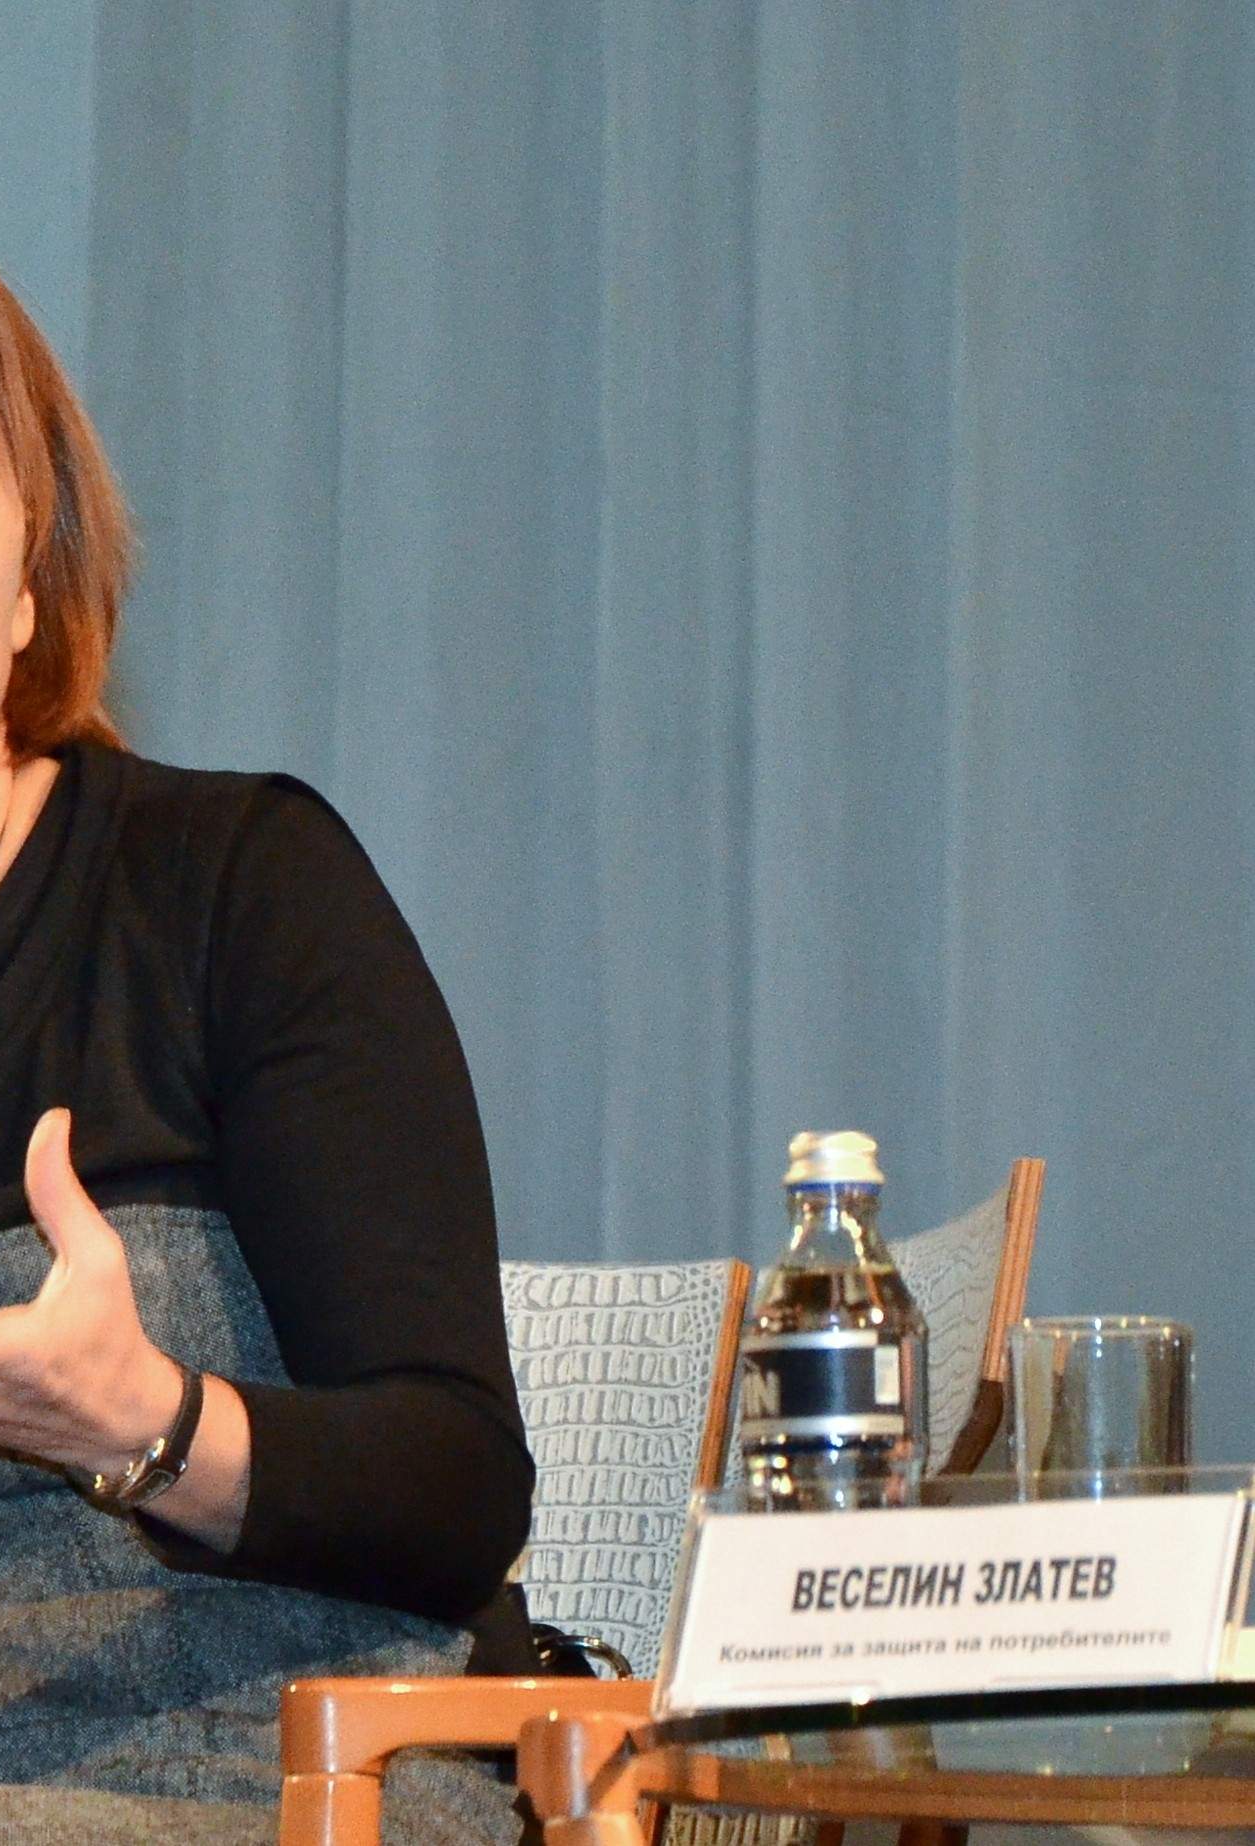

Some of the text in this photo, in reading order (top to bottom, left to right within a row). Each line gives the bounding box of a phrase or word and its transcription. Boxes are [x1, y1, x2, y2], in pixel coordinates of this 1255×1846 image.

[792, 1555, 1116, 1612] ВЕСЕЛИН ЗЛАТЕВ
[719, 1628, 1172, 1663] Комисия за защита на потребителите
